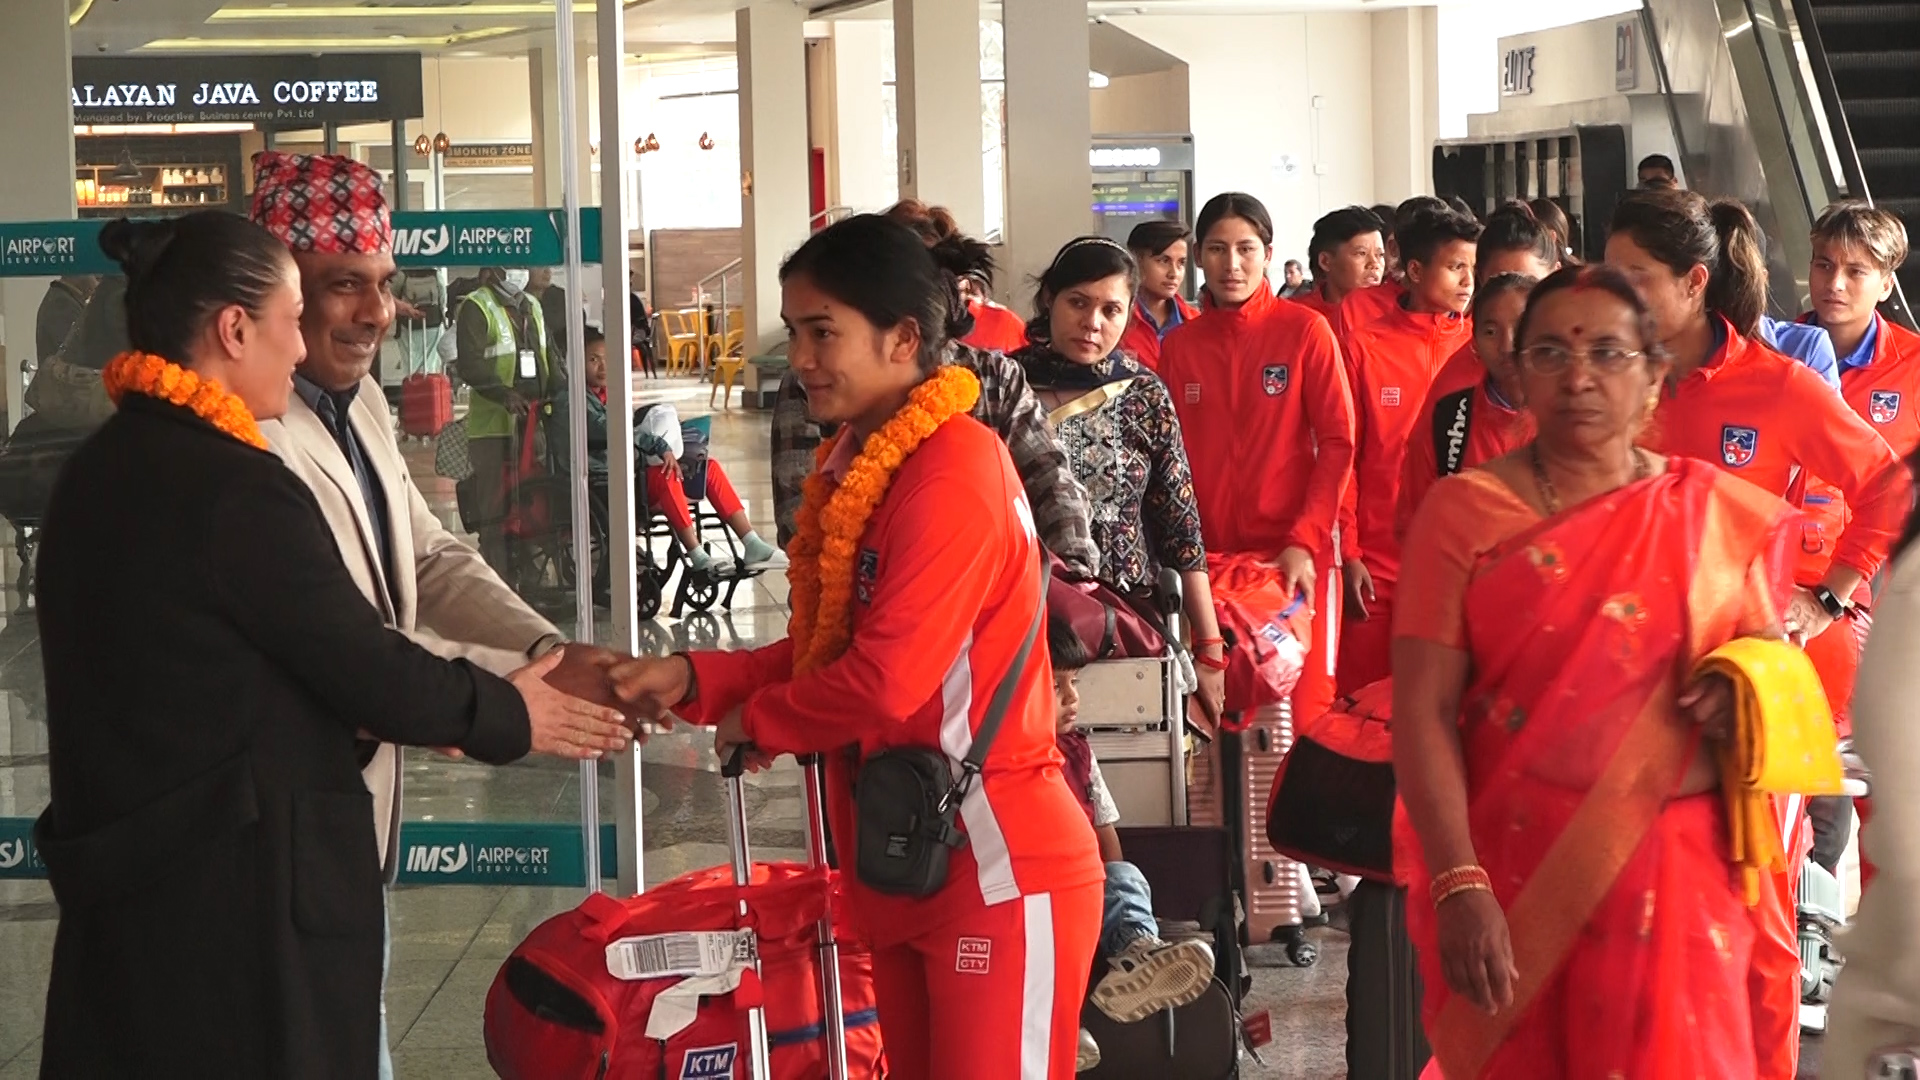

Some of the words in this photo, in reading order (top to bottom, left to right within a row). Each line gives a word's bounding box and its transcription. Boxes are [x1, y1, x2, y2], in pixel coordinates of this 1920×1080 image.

[193, 83, 260, 105] JAVA
[273, 81, 378, 103] COFFEE
[146, 112, 195, 122] Proactive
[200, 112, 239, 121] Business
[298, 109, 315, 118] Ltd
[458, 227, 533, 245] AIRPORT
[7, 237, 76, 255] AIRPORT
[459, 246, 531, 255] SERVICES
[477, 847, 550, 864] AIRPORT
[477, 865, 548, 874] SERVICES
[961, 943, 988, 952] KTM
[689, 1051, 729, 1074] KTM
